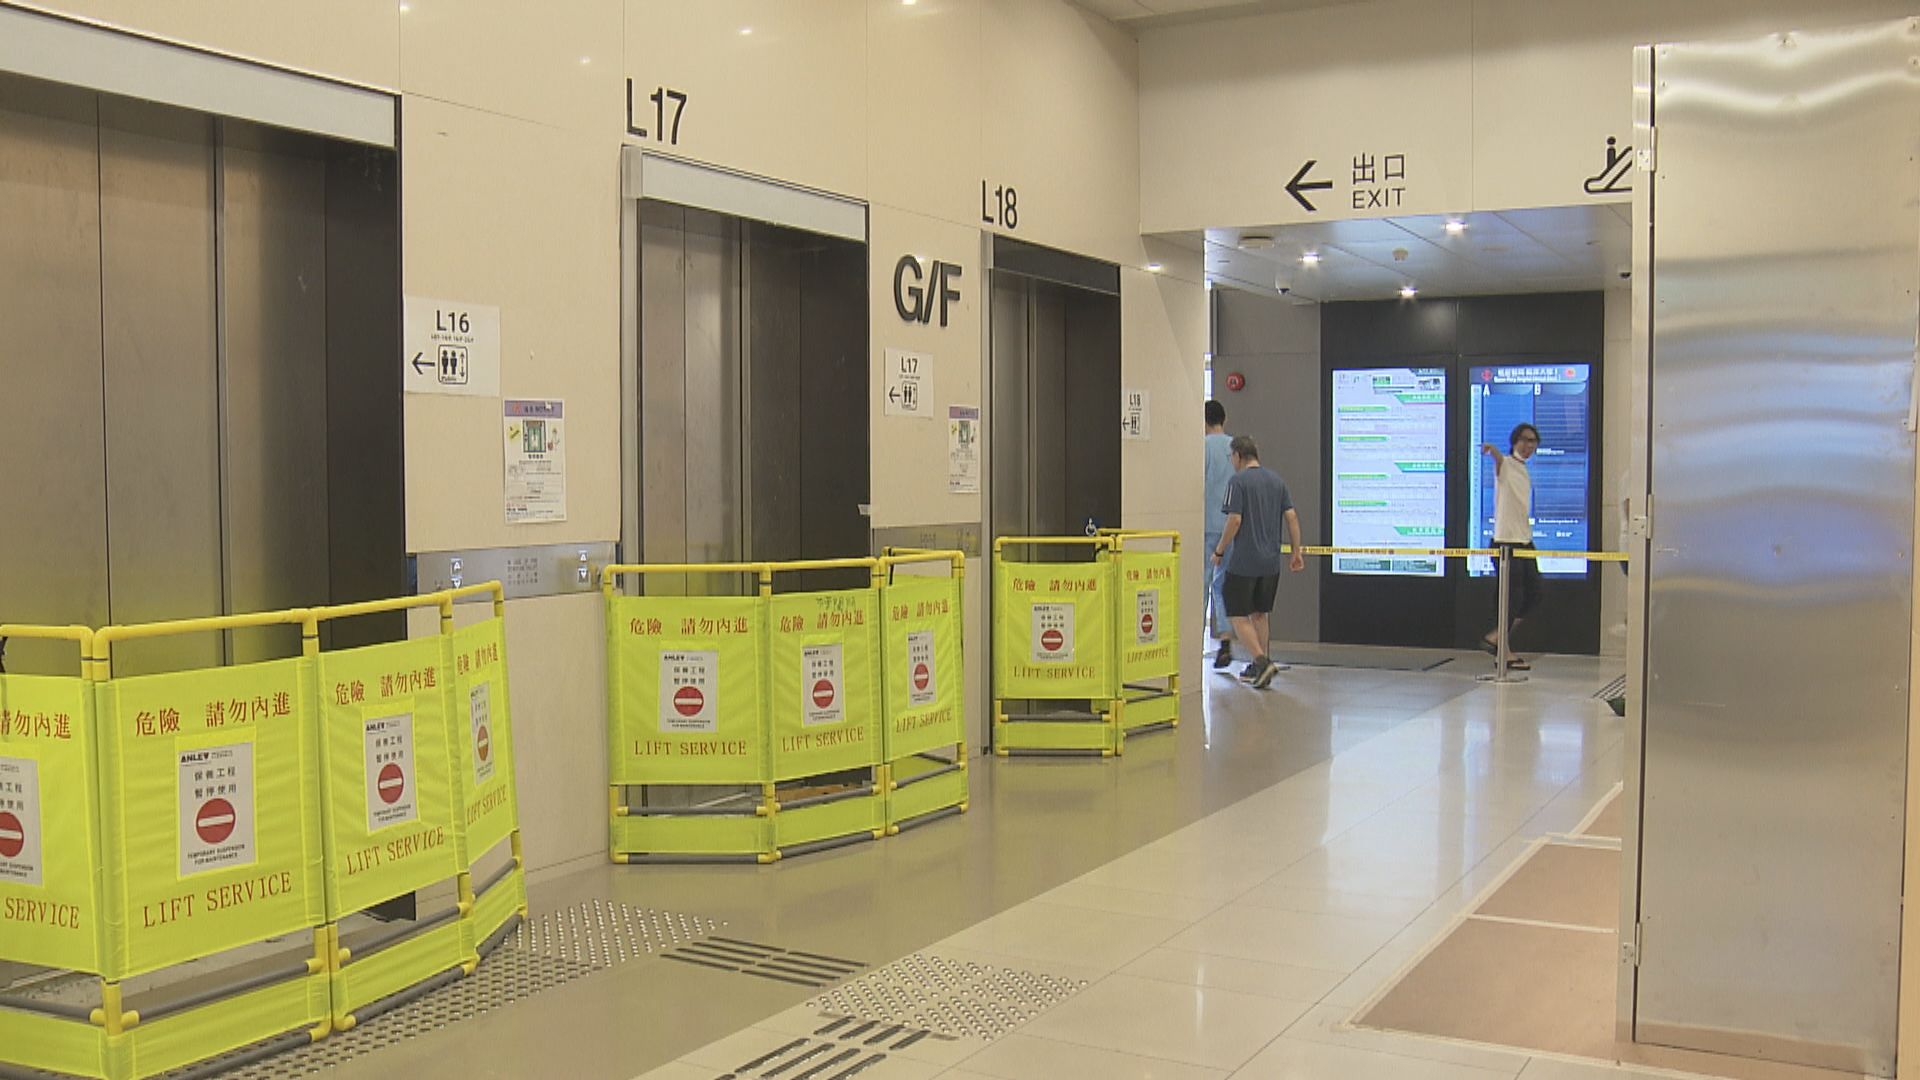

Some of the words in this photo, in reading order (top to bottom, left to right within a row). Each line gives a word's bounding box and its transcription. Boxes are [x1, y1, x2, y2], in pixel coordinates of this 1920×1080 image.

[621, 78, 687, 146] L17
[1353, 153, 1405, 185] 出口
[981, 180, 1018, 236] L18
[1353, 188, 1405, 209] EXIT
[894, 255, 962, 327] G/F
[437, 310, 470, 333] L16
[901, 356, 918, 374] L17
[1129, 394, 1141, 407] L18
[629, 617, 663, 637] 危險
[680, 616, 749, 637] 請勿內進
[335, 681, 365, 705] 危險
[379, 666, 437, 698] 請勿內進
[1013, 665, 1041, 678] LIFT
[1046, 665, 1096, 679] SERVICE
[135, 707, 181, 737] 危險
[205, 691, 292, 728] 請勿內進
[634, 740, 672, 756] LIFT
[680, 740, 748, 757] SERVICE
[782, 734, 811, 753] LIFT
[814, 726, 864, 748] SERVICE
[346, 845, 381, 876] LIFT
[386, 826, 445, 862] SERVICE
[4, 896, 80, 929] SERVICE
[143, 894, 195, 928] LIFT
[206, 871, 292, 913] SERVICE
